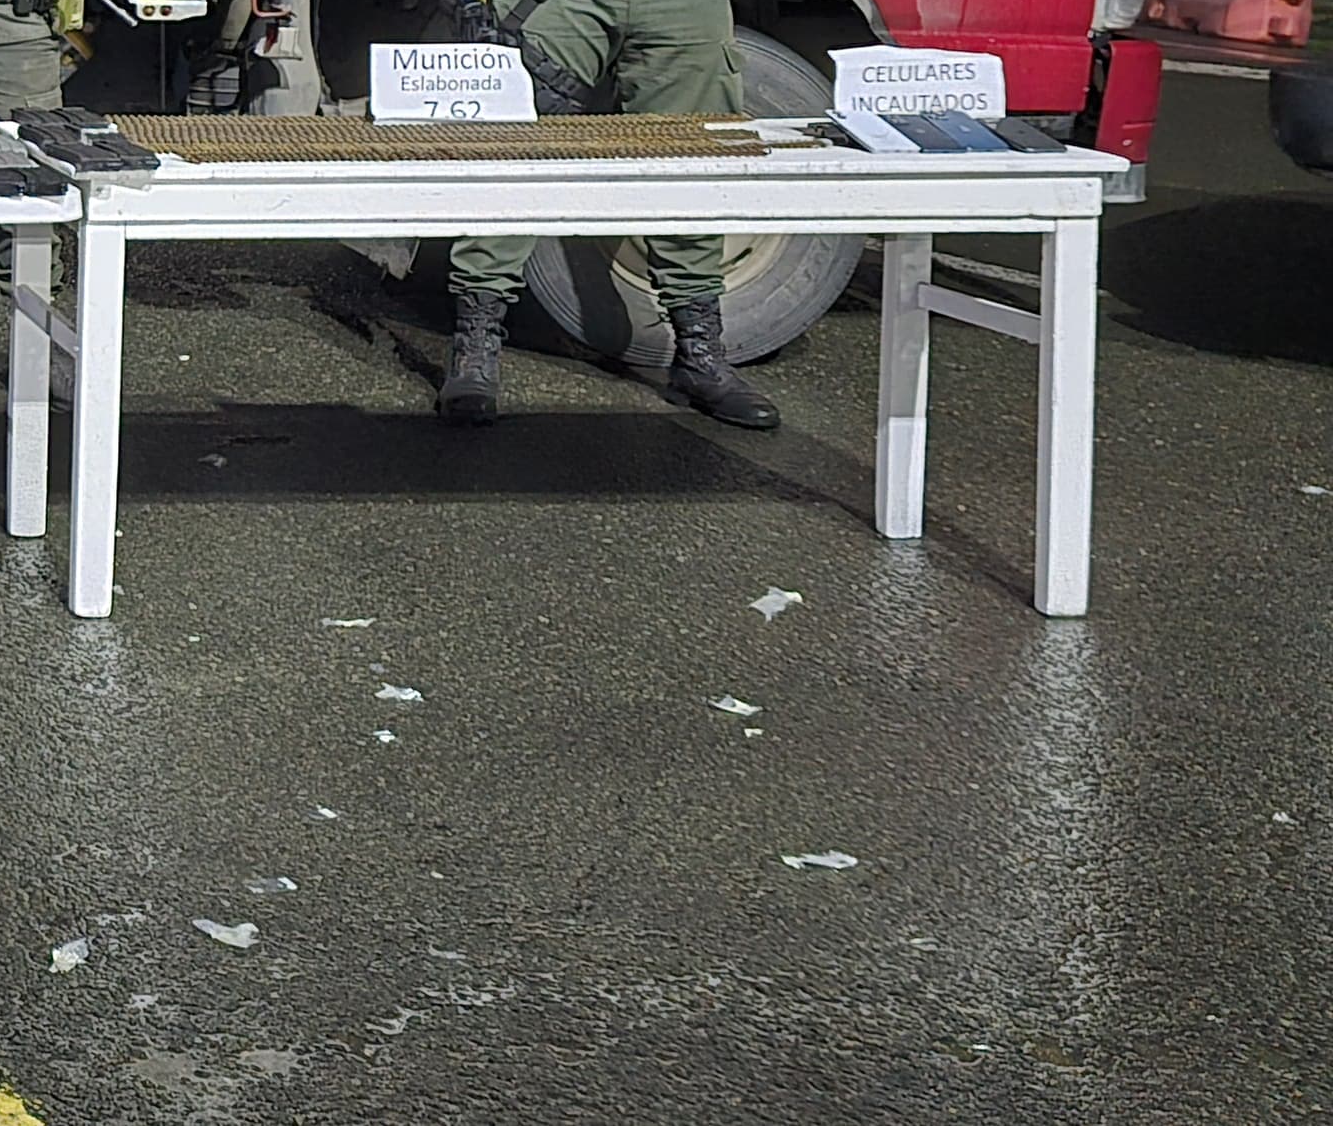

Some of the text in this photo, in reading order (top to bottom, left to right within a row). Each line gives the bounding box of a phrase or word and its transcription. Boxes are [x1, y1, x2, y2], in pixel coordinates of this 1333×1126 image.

[393, 47, 512, 71] Munición
[401, 74, 502, 92] Eslabonada
[862, 62, 976, 84] CELULARES
[851, 92, 989, 113] INCAUTADOS
